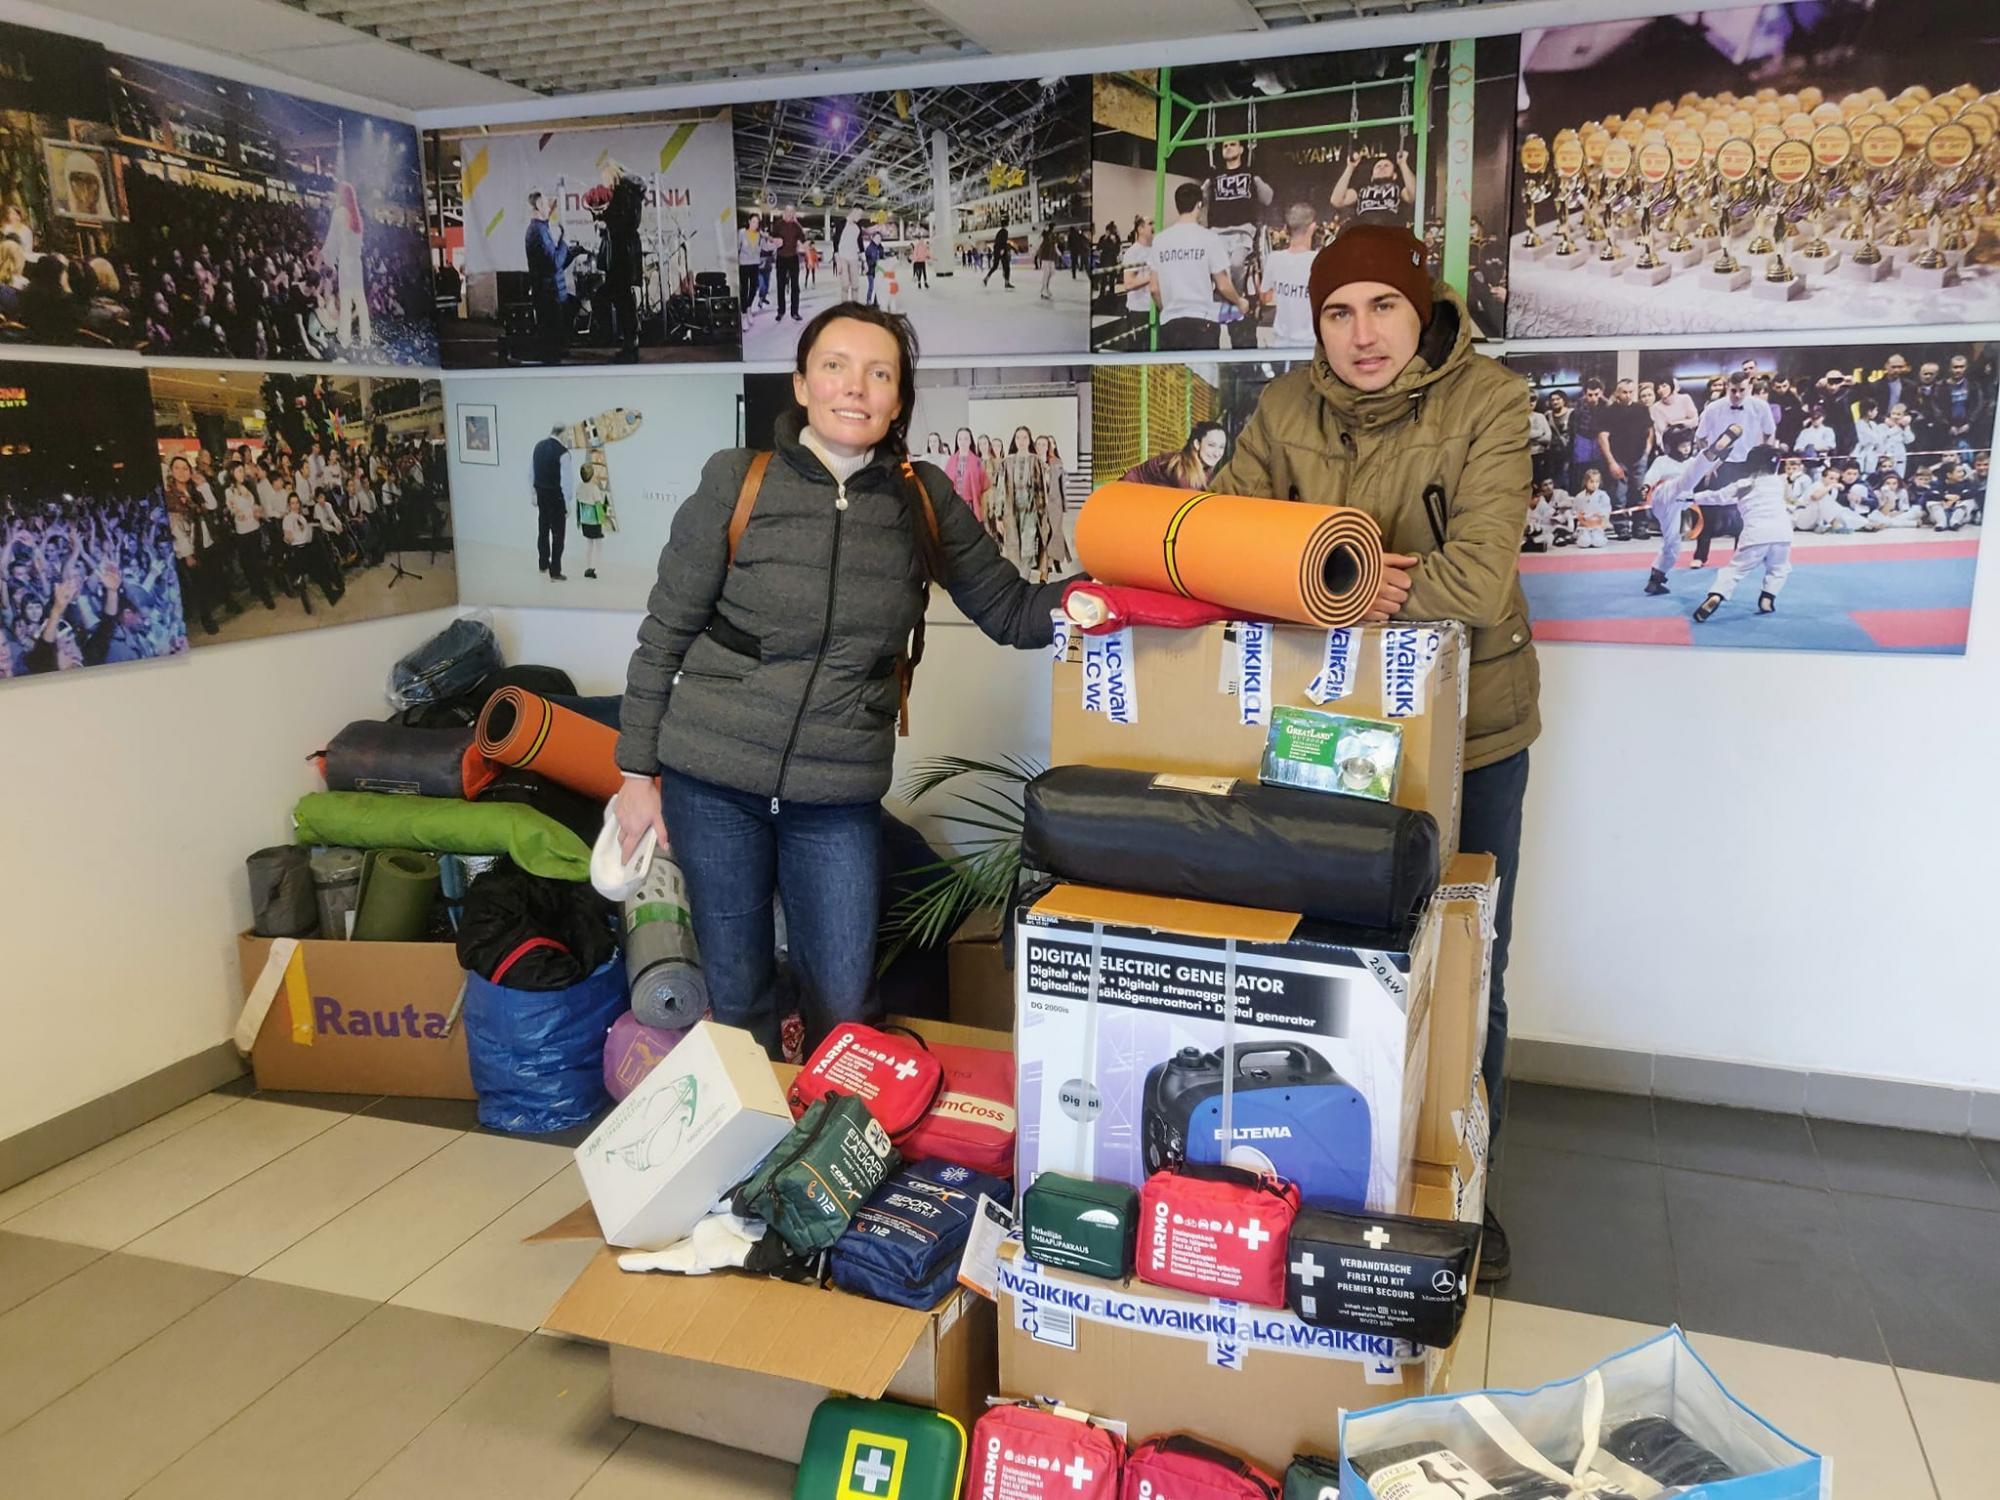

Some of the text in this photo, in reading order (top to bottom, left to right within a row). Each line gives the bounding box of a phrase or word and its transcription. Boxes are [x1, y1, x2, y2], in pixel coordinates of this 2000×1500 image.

[1159, 248, 1205, 262] ВОЛОНТЕР
[1086, 650, 1101, 678] LC
[1106, 641, 1122, 669] LC
[1030, 946, 1285, 994] DIGITAL ELECTRIC GENEATOR
[1031, 965, 1069, 979] Digitalt
[1072, 970, 1106, 985] elvk
[1118, 977, 1159, 991] Digitalt
[1369, 957, 1404, 994] 2.0 kW
[1031, 977, 1089, 995] Digitaaline
[1099, 988, 1202, 1011] sähkögeneraattori
[1256, 1010, 1316, 1027] generator
[1031, 1002, 1043, 1010] DG
[313, 996, 448, 1039] Rauta
[812, 1033, 855, 1074] TARMO
[1063, 1094, 1099, 1107] Digal
[843, 1136, 879, 1185] LAUKKU
[817, 1191, 836, 1215] 112
[887, 1193, 943, 1216] SPORT
[869, 1224, 891, 1237] 112
[1152, 1201, 1169, 1271] TARMO
[1031, 1233, 1089, 1254] ENSIAPUPAKKAUS
[1340, 1258, 1412, 1275] VERBANDTASCHE
[1337, 1282, 1415, 1300] PREMIER SECOURS
[1347, 1272, 1405, 1287] FIRST AID KIT
[1106, 1300, 1136, 1321] LC
[1253, 1319, 1286, 1341] LC
[983, 1437, 1001, 1500] ARMO
